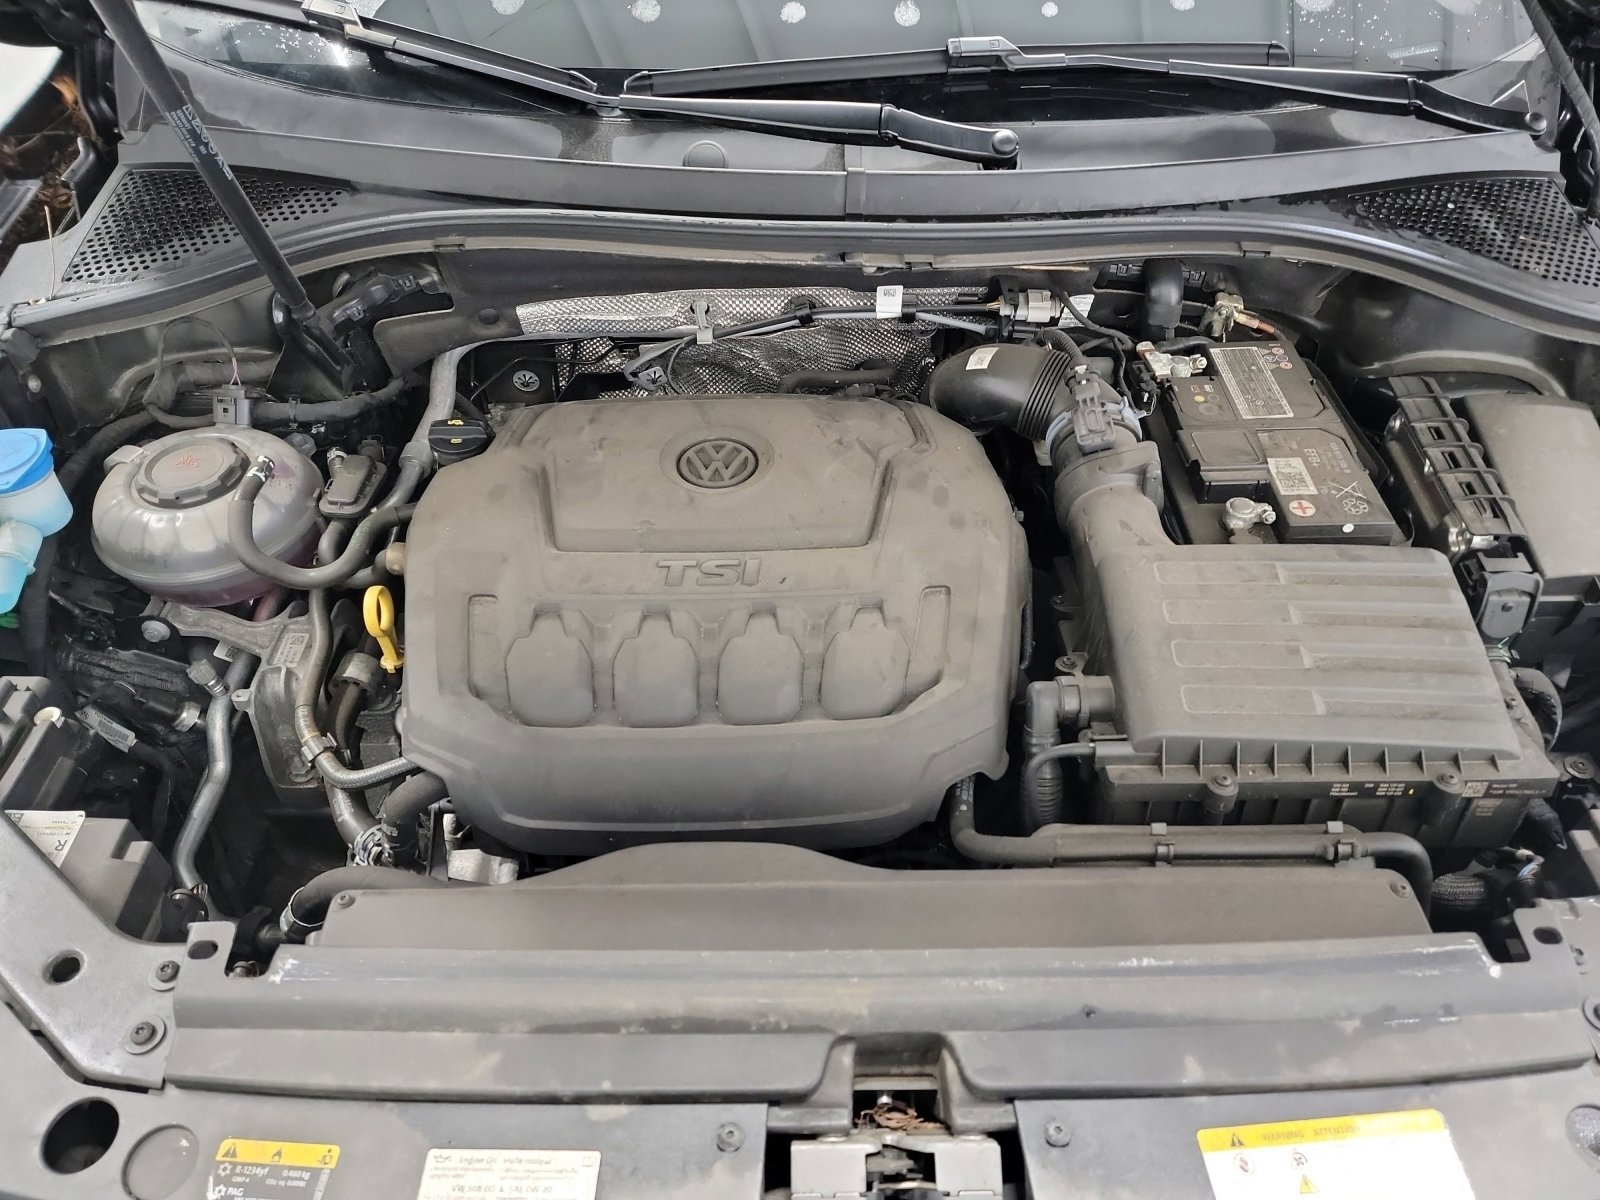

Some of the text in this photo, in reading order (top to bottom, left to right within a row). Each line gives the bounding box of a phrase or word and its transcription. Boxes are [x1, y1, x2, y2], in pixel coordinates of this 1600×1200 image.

[656, 559, 762, 587] TSI
[54, 839, 68, 852] R
[1261, 1124, 1360, 1142] WARNING ATTENTION
[235, 1165, 270, 1177] R-1234yf
[226, 1186, 245, 1197] PAG
